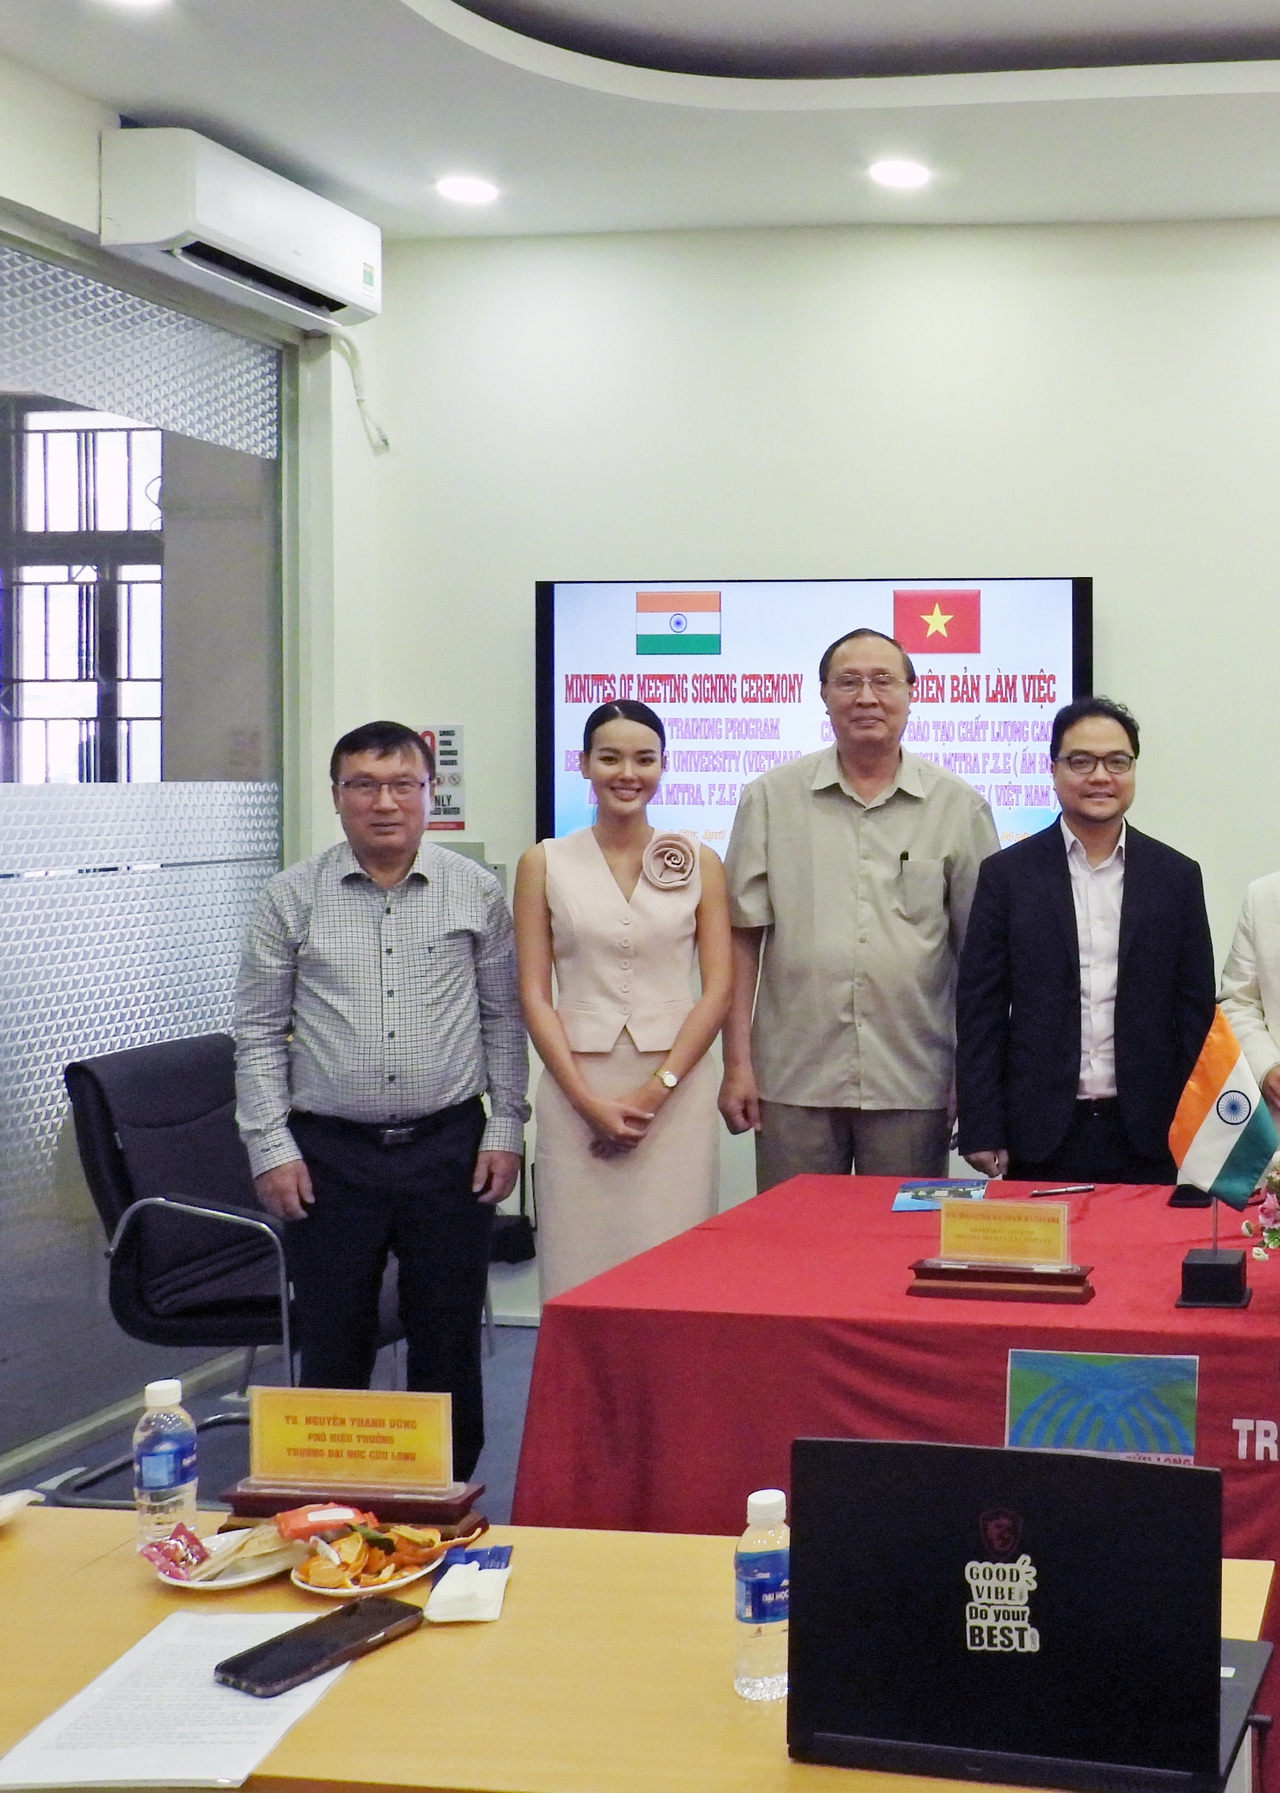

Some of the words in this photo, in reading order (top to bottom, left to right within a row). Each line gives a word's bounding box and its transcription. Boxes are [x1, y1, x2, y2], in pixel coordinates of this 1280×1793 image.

[564, 674, 616, 703] MINUTES
[619, 674, 634, 702] OF
[637, 674, 689, 703] MEETING
[691, 674, 737, 703] SIGNING
[741, 674, 803, 703] CEREMONY
[950, 666, 981, 703] BẢN
[985, 667, 1017, 703] LÀM
[1022, 668, 1056, 709] VIỆC
[667, 717, 722, 740] TRAINING
[725, 717, 780, 740] PROGRAM
[907, 716, 931, 742] ĐÀO
[932, 720, 955, 745] TẠO
[957, 713, 989, 742] CHẤT
[673, 750, 741, 772] UNIVERSITY
[1020, 746, 1037, 774] ẤN
[665, 783, 705, 807] MITRA,
[994, 781, 1022, 810] VIỆT
[1024, 785, 1051, 806] NAM
[970, 1566, 1020, 1583] GOOD
[969, 1606, 988, 1620] Do
[994, 1609, 1027, 1623] your
